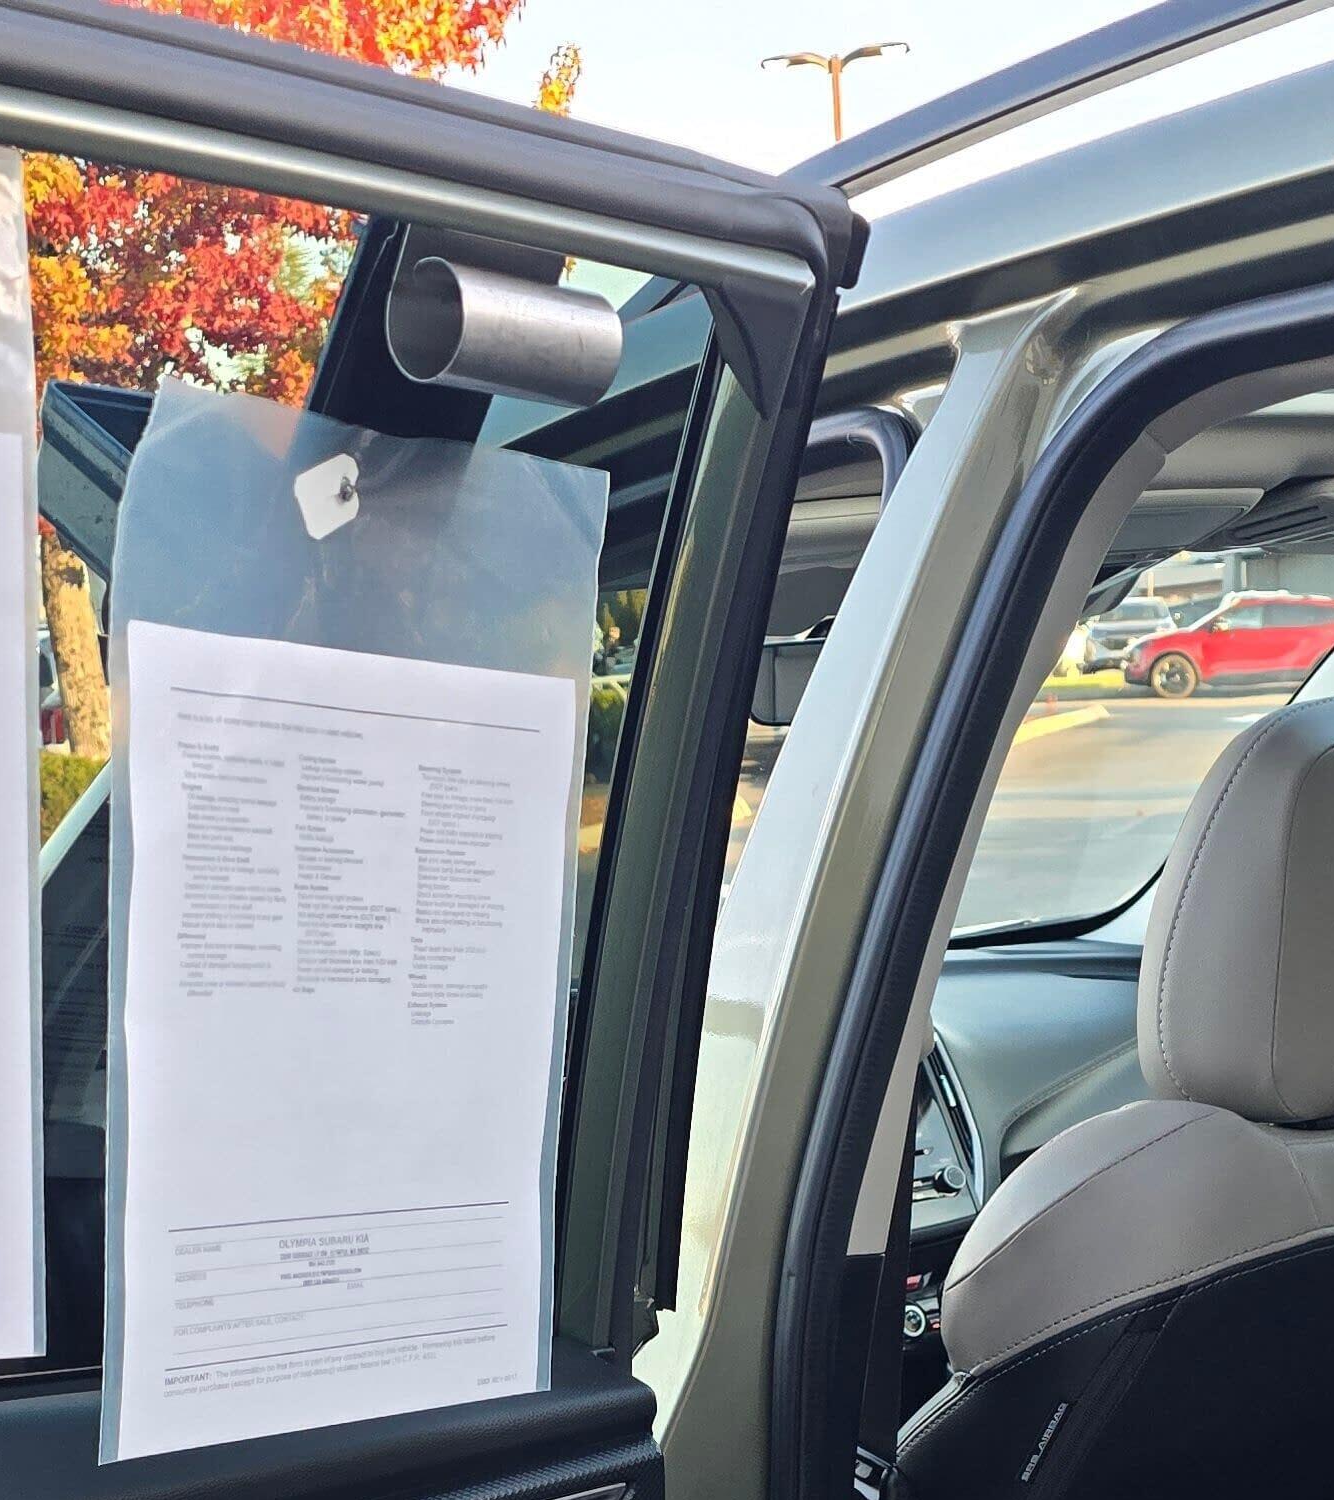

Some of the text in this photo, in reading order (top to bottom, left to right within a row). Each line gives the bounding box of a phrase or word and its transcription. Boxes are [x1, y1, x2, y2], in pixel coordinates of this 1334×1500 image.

[279, 1233, 370, 1249] OLYMPIA SUBARU KIA
[1038, 1402, 1069, 1457] AIRBAG
